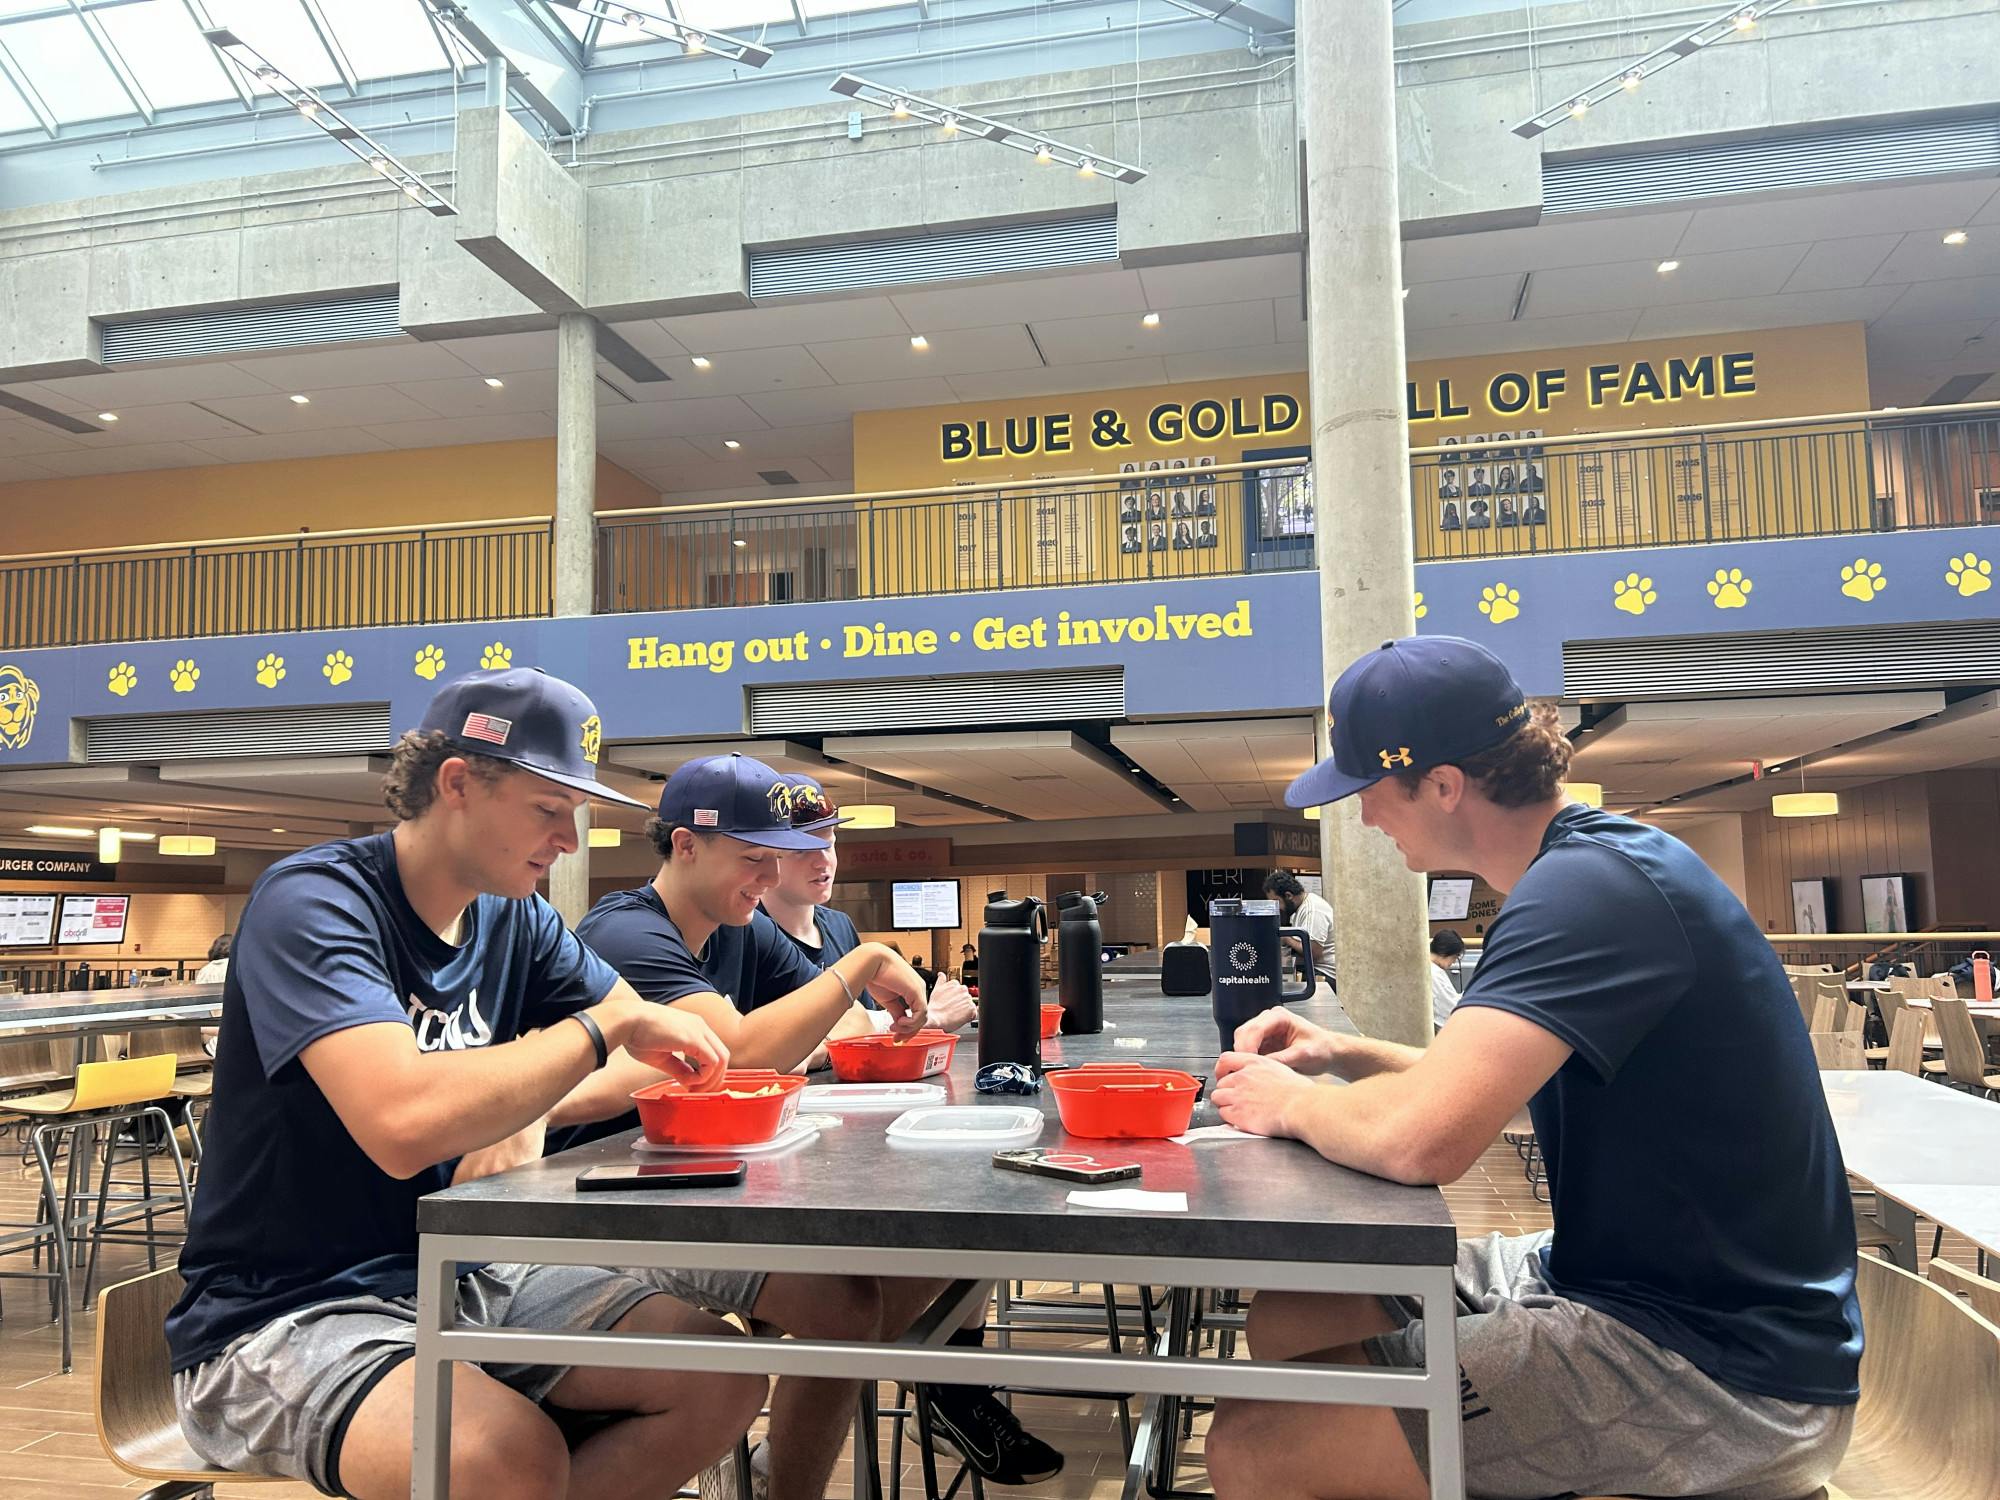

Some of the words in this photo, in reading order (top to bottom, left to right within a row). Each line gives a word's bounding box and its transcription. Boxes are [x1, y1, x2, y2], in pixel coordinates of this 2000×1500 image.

[942, 413, 1072, 461] BLUE
[1091, 409, 1132, 448] &
[1148, 394, 1300, 442] GOLD
[1407, 379, 1470, 420] LL
[1488, 368, 1566, 413] OF
[1589, 352, 1756, 406] FAME
[628, 636, 735, 673] Hang
[744, 631, 808, 663] out
[843, 622, 938, 658] Dine
[972, 617, 1047, 651] Get
[1057, 600, 1253, 646] involved
[0, 860, 33, 871] URGER
[36, 860, 91, 873] COMPANY
[1218, 975, 1270, 986] capitahealth
[408, 987, 492, 1052] TCNJ
